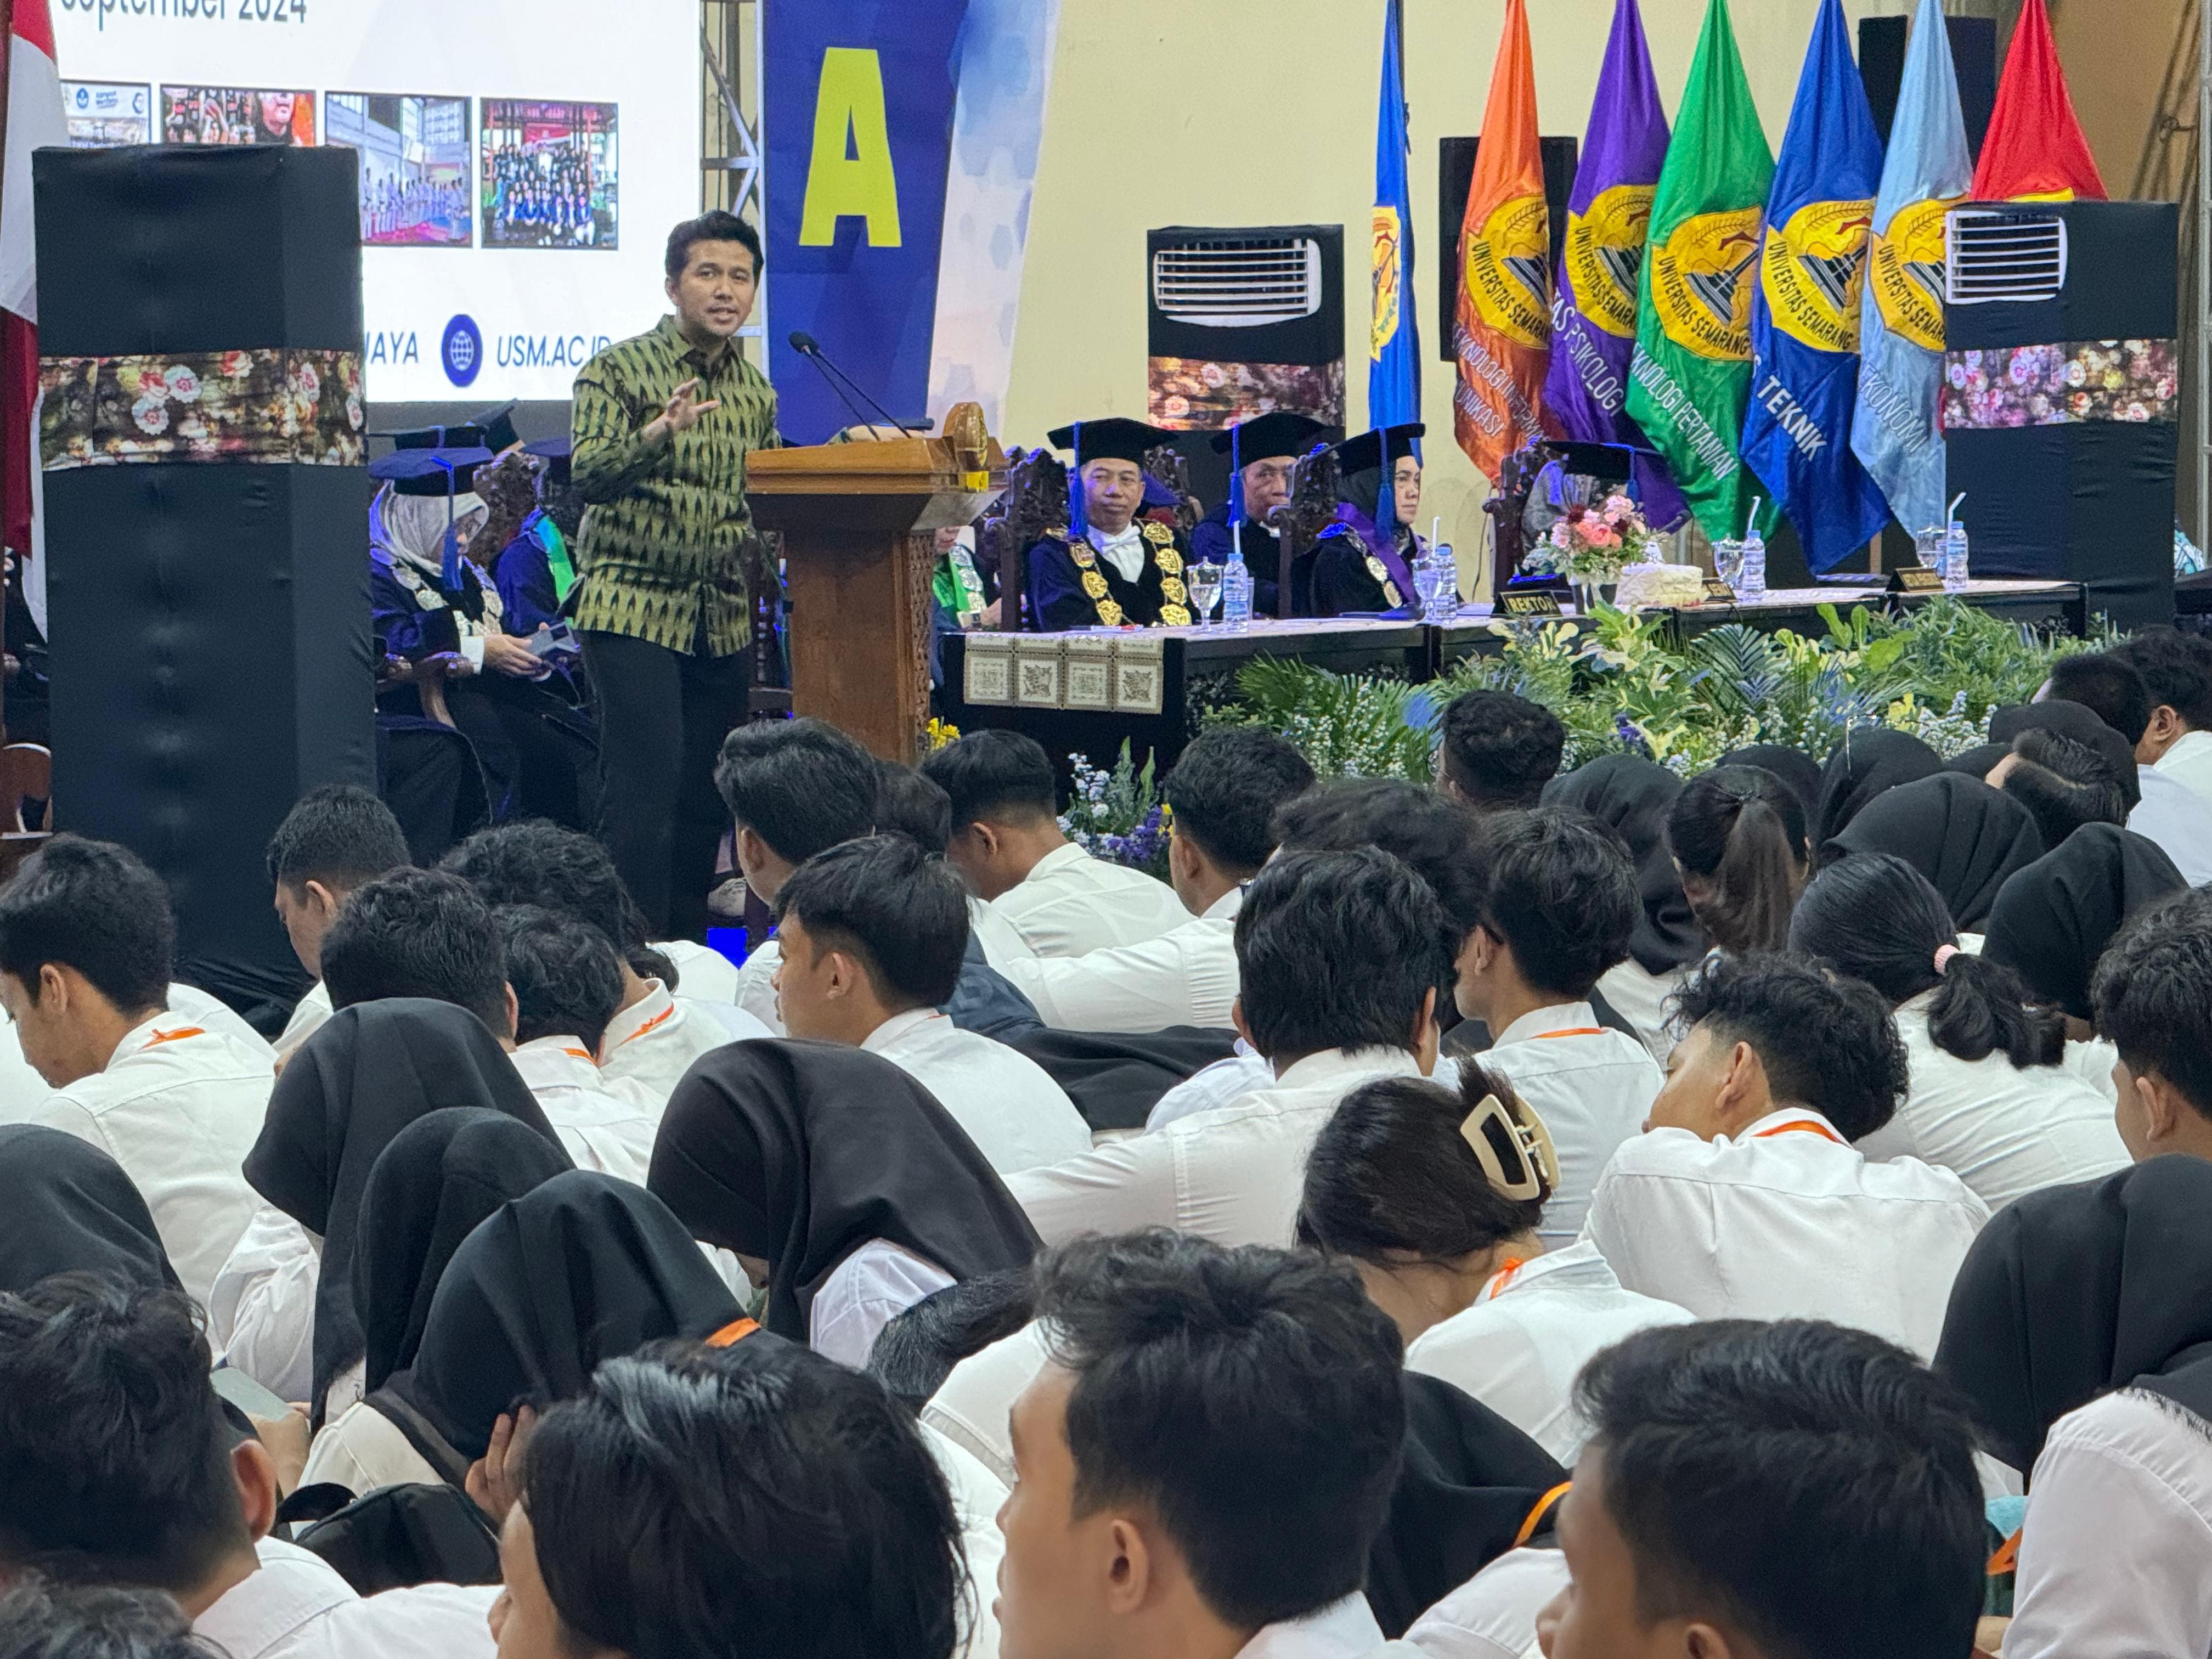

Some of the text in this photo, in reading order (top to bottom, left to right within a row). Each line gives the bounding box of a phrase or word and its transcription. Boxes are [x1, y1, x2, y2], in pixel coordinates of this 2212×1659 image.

[799, 47, 901, 247] A
[1472, 241, 1515, 312] UNIVERSITAS
[1575, 225, 1606, 298] UNIVERSITAS
[1768, 241, 1854, 350] UNIVERSITAS SEMARANG
[1878, 244, 1918, 315] UNIVERSITAS
[1658, 255, 1750, 356] UNIVERSITAS SEMARANG
[1672, 400, 1739, 481] PERTANIAN
[1757, 375, 1827, 462] TEKNIK
[1507, 596, 1557, 613] REKTOR
